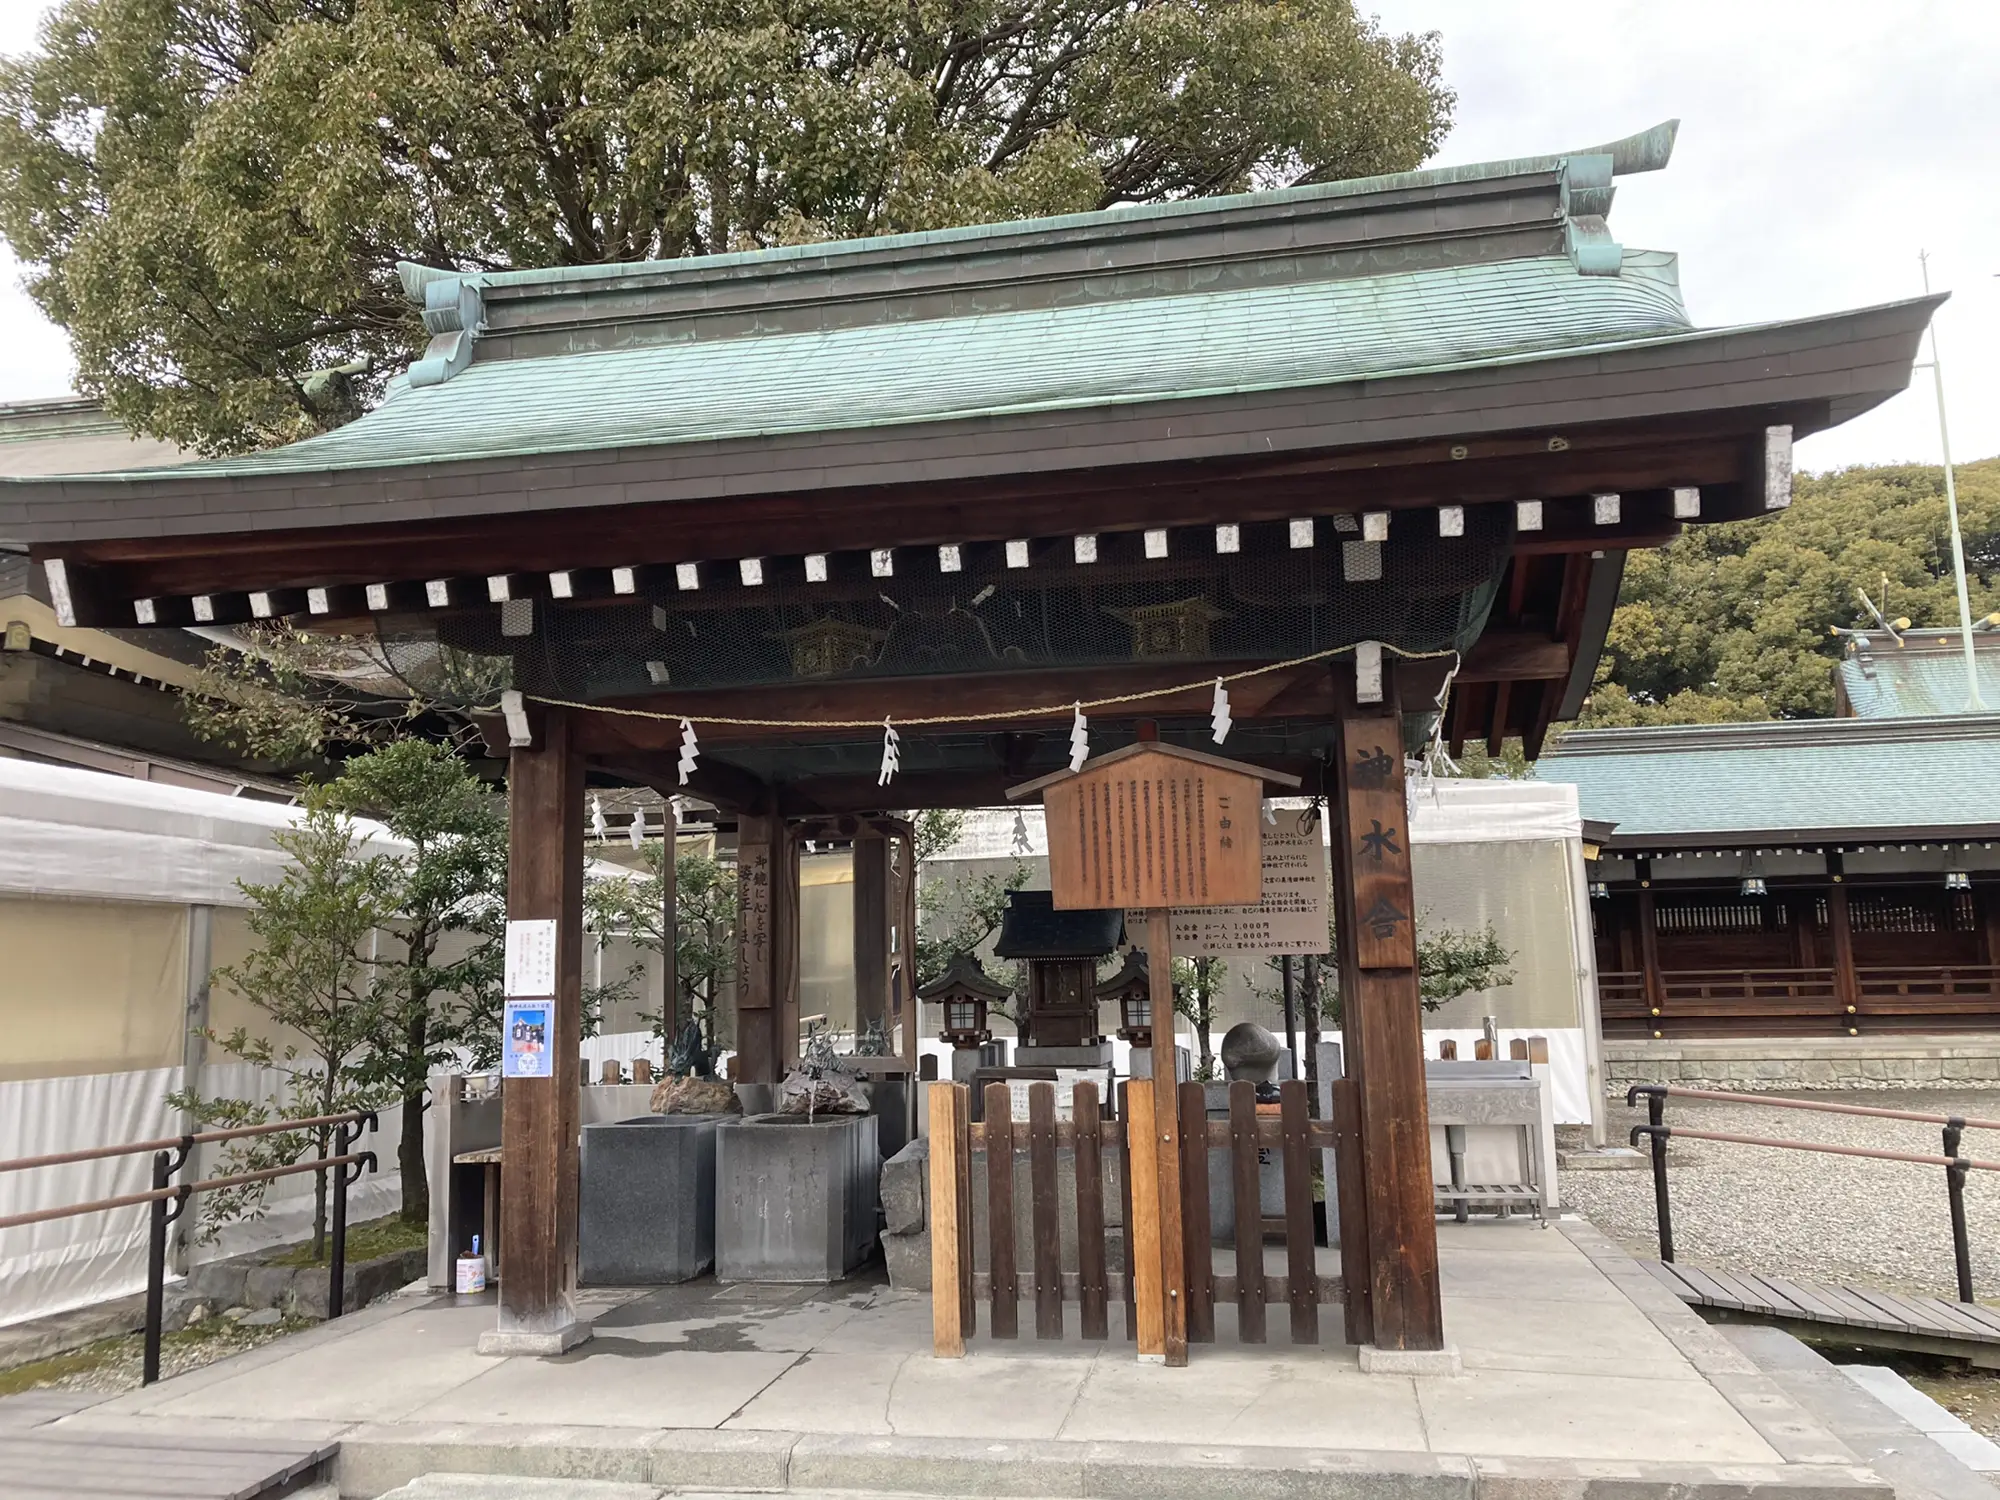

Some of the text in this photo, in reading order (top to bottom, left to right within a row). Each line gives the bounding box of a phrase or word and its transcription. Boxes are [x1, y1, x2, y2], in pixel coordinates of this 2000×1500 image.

[1219, 796, 1234, 849] ご由緒
[1262, 876, 1316, 884] 之宮の真清田神社を
[738, 864, 753, 997] 姿を正しましょう
[753, 855, 768, 963] 御鏡に心を写し
[1175, 933, 1198, 941] 年会費
